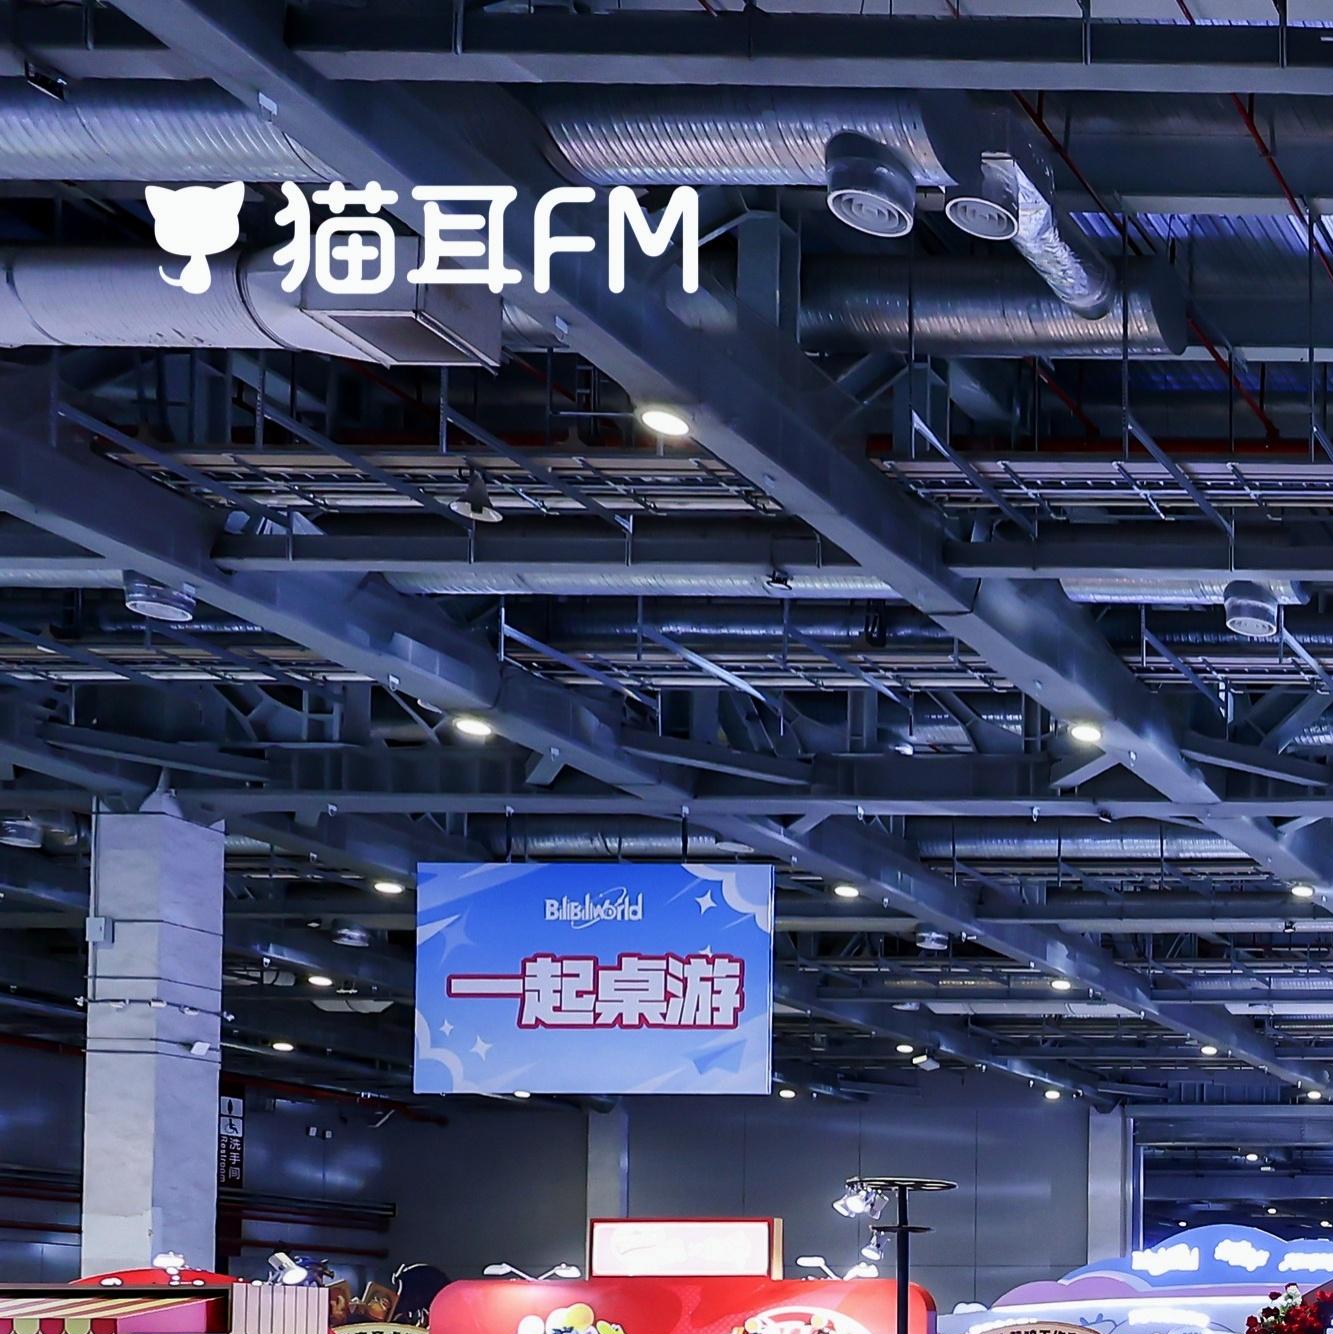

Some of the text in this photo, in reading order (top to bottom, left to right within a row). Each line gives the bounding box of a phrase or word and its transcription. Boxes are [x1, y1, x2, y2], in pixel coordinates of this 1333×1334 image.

[449, 954, 743, 1028] 一起桌游
[229, 1138, 241, 1179] 洗手间
